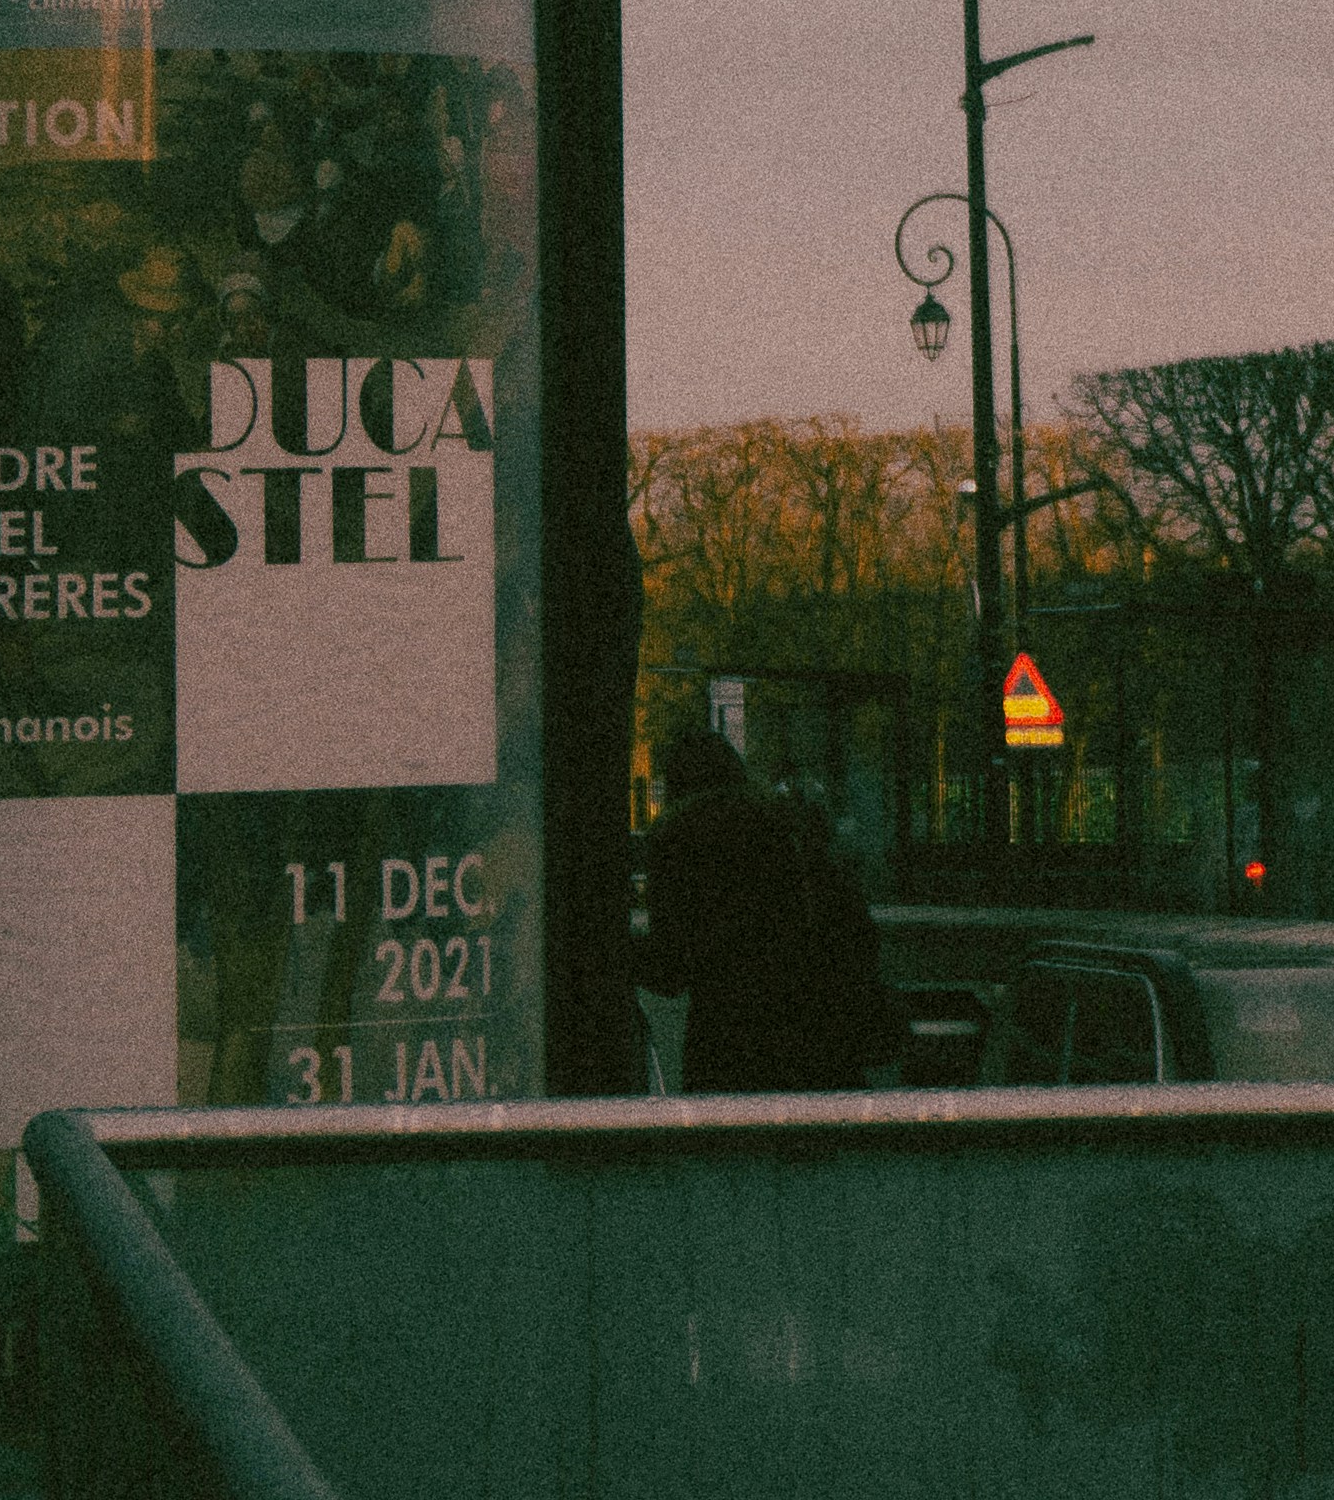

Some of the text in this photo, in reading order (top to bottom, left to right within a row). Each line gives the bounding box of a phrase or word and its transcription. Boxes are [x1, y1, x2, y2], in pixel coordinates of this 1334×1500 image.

[201, 357, 496, 454] DUCA
[174, 466, 466, 568] STEL
[286, 855, 495, 923] 11 DEC.
[376, 936, 493, 1003] 2021
[288, 1036, 499, 1105] 31 JAN.
